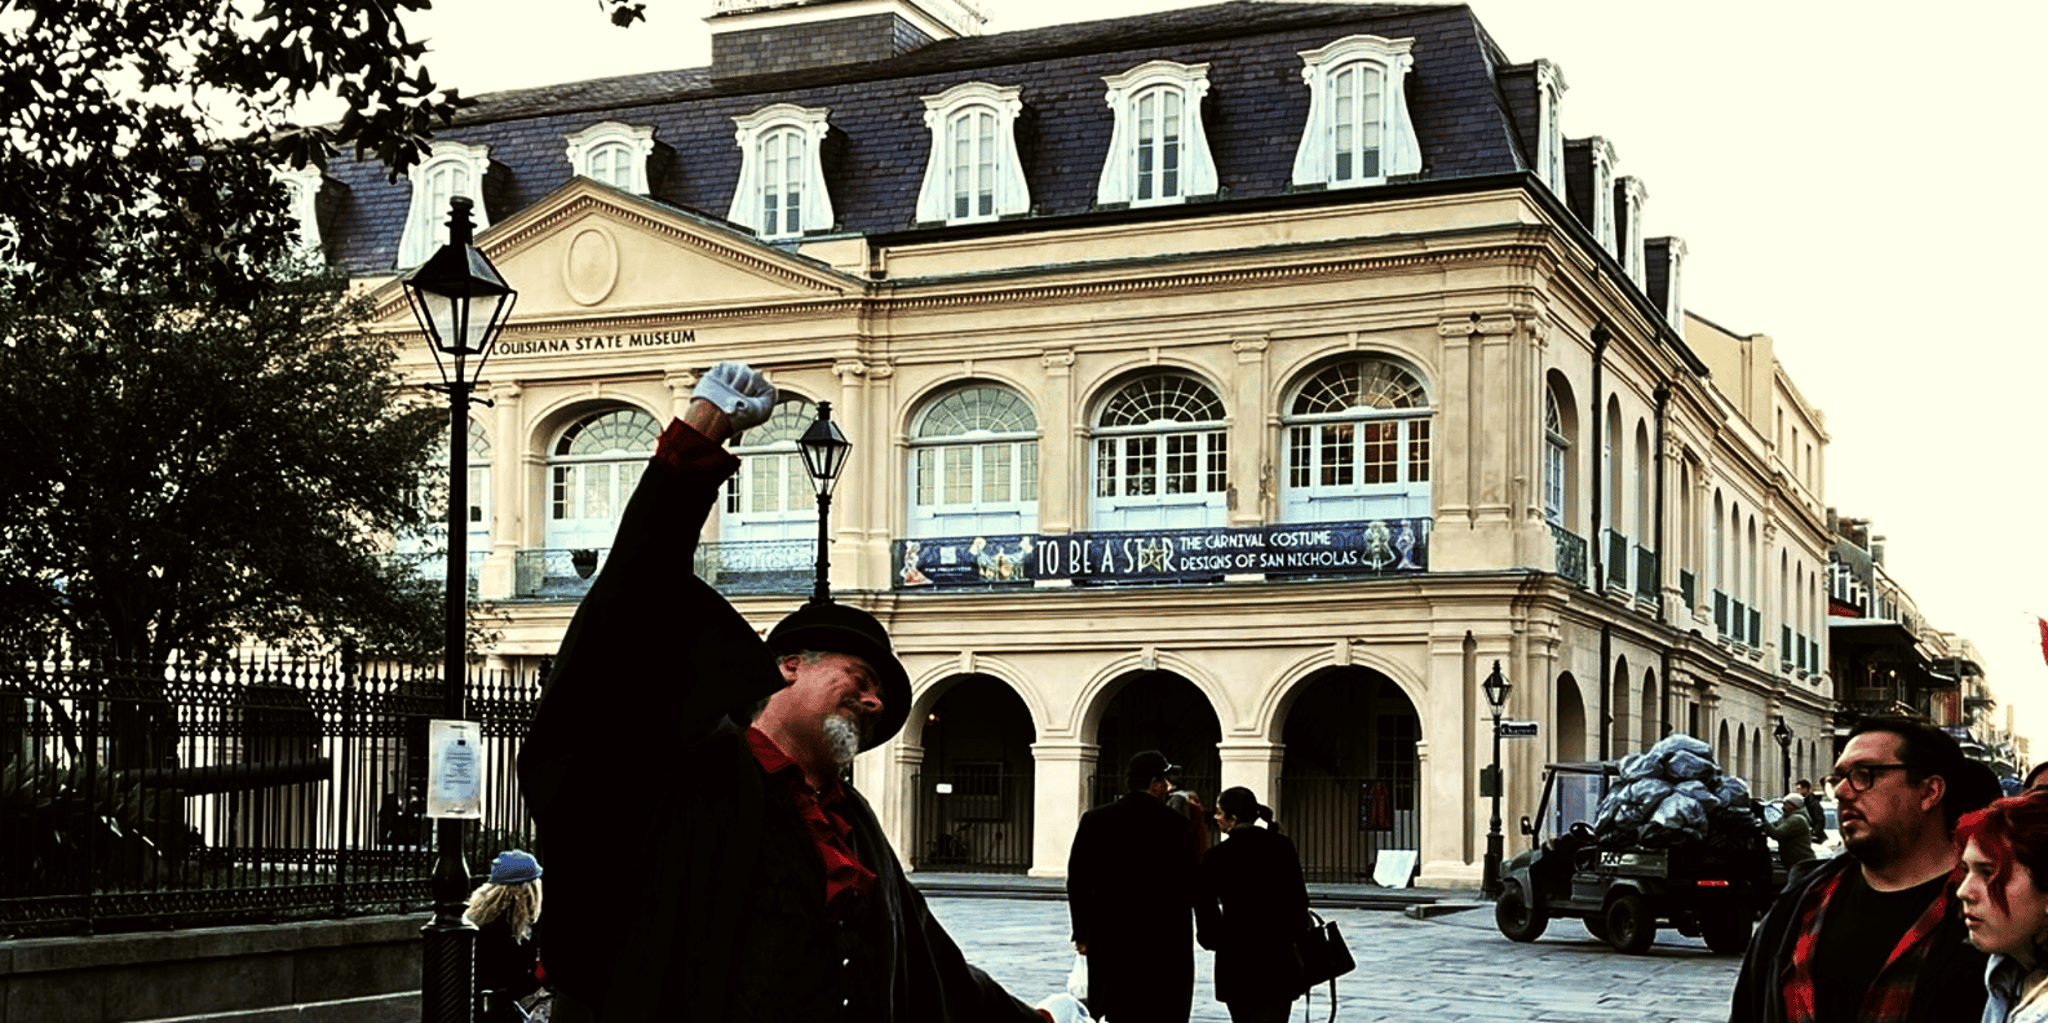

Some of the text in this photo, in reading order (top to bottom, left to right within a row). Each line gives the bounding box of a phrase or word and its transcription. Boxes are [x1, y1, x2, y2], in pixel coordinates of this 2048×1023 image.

[492, 330, 696, 355] LOUISIANA STATE MUSEUM
[1180, 530, 1331, 550] THE CARNIVAL COSTUME
[1037, 537, 1177, 575] TO BE A STAR
[1180, 550, 1358, 571] DESIGNS OF SAN NICHOLAS
